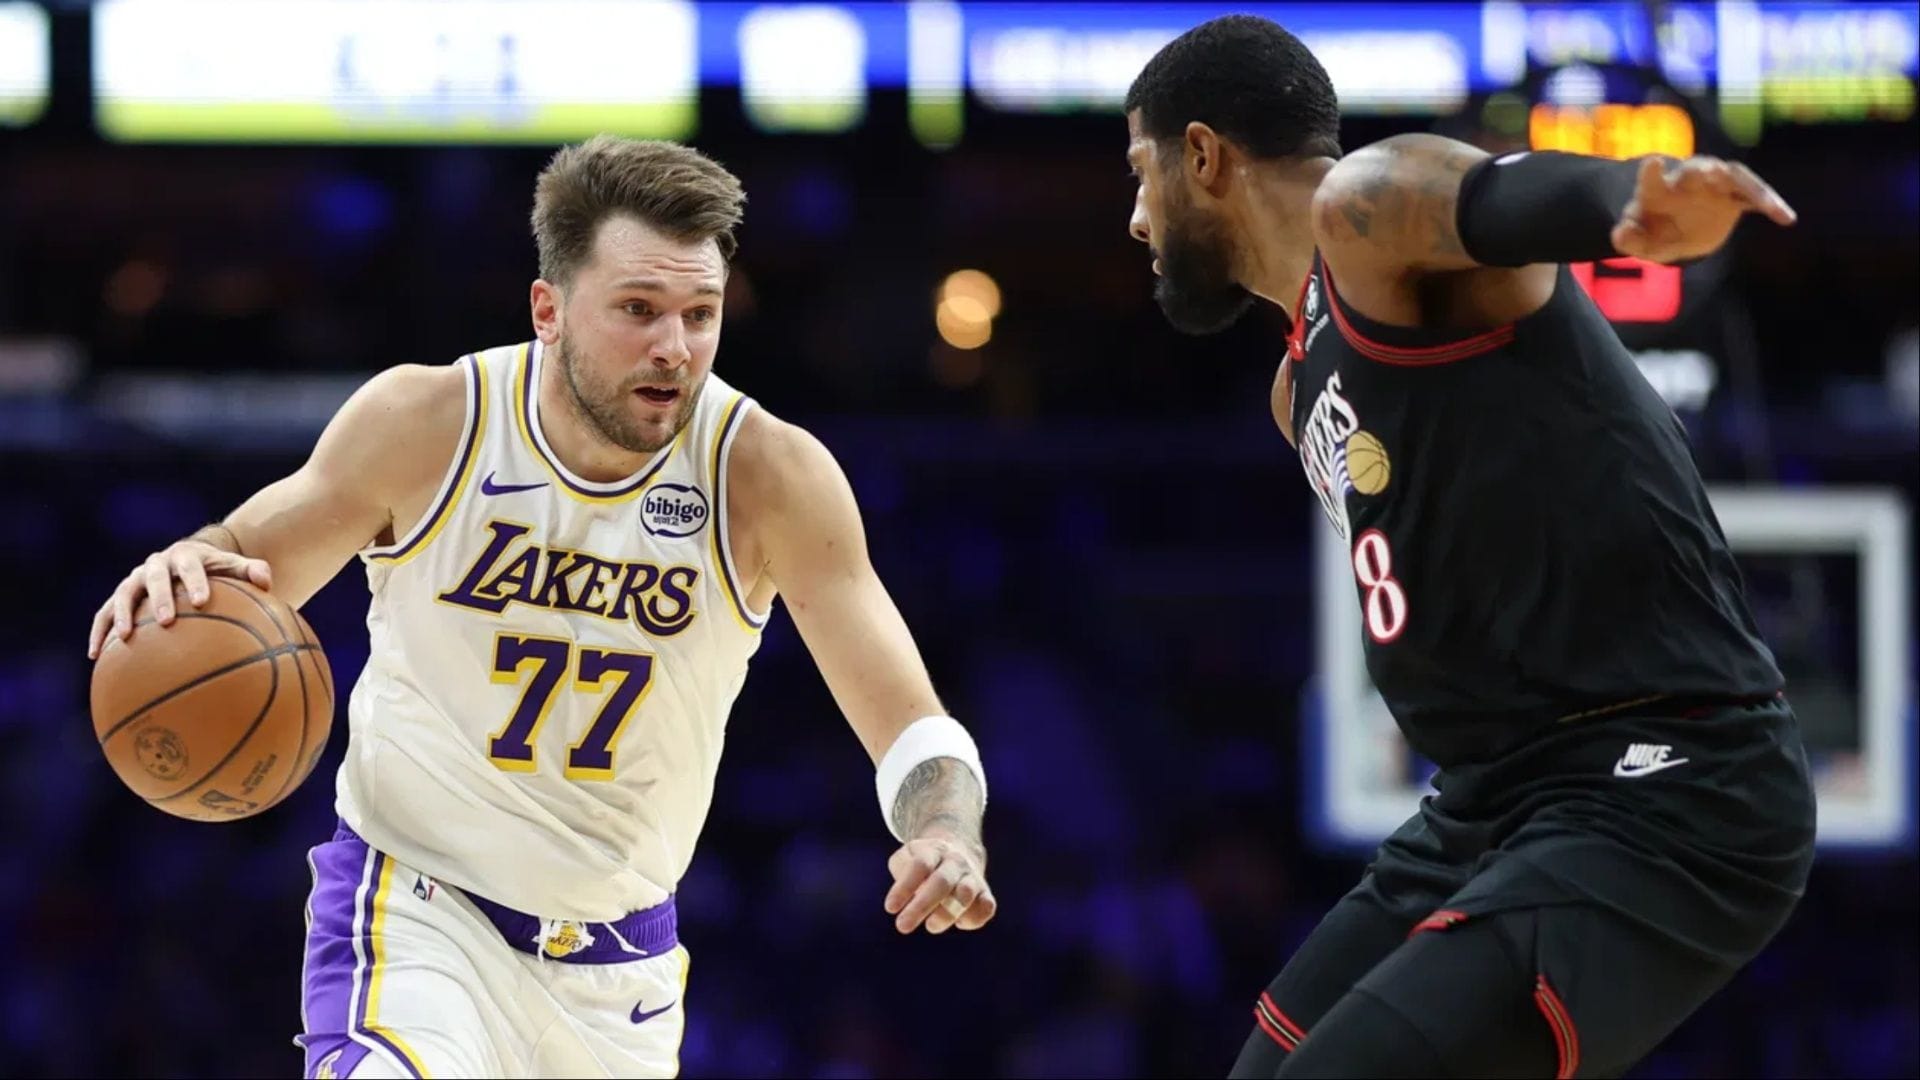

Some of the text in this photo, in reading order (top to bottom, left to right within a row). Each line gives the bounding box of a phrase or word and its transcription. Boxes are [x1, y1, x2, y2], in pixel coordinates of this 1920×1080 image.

[645, 497, 705, 523] bibigo
[434, 519, 701, 640] LAKERS
[1353, 528, 1408, 643] 8
[486, 630, 656, 782] 77
[1622, 743, 1672, 768] NIKE
